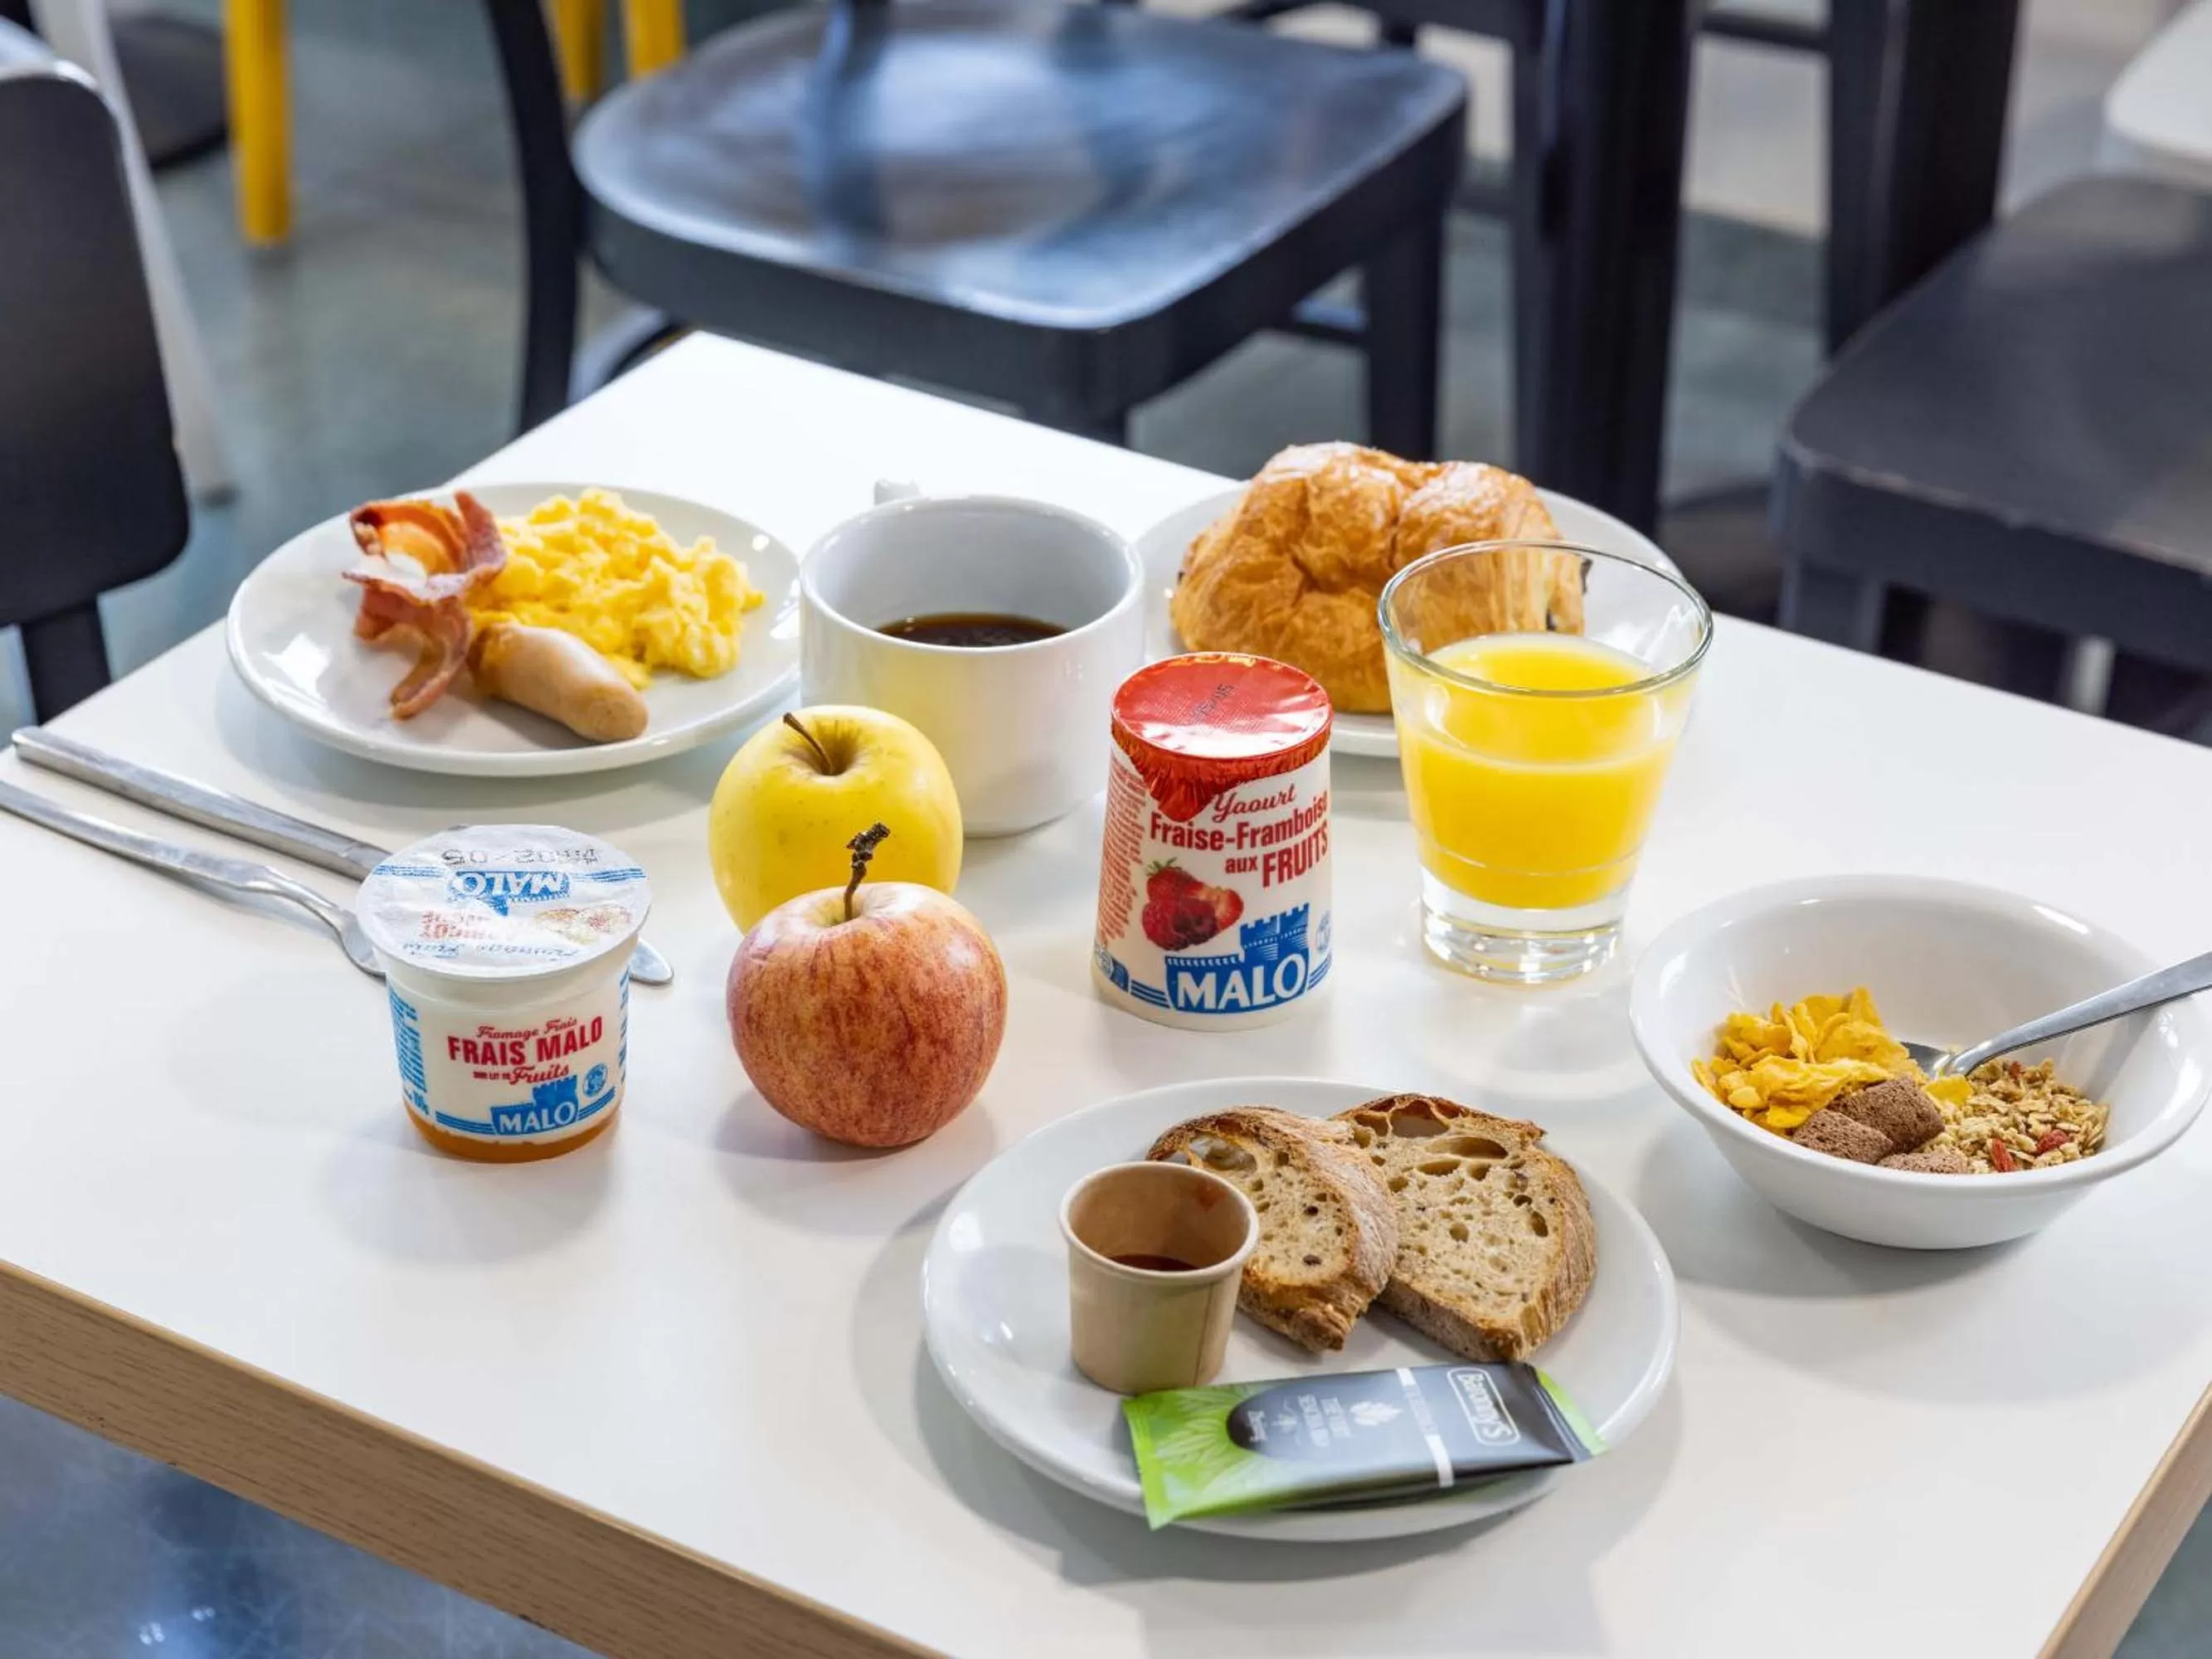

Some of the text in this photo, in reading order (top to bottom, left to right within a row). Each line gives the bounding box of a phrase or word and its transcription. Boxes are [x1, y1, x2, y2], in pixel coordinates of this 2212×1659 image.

[1213, 783, 1297, 823] Yaourt
[1225, 820, 1327, 888] aux FRUITS
[458, 872, 563, 897] MALO
[1177, 953, 1305, 1010] MALO
[448, 1016, 602, 1066] FRAIS MALO
[477, 1016, 577, 1040] Fromage Frais
[508, 1063, 569, 1085] Fruits
[499, 1101, 576, 1134] MALO
